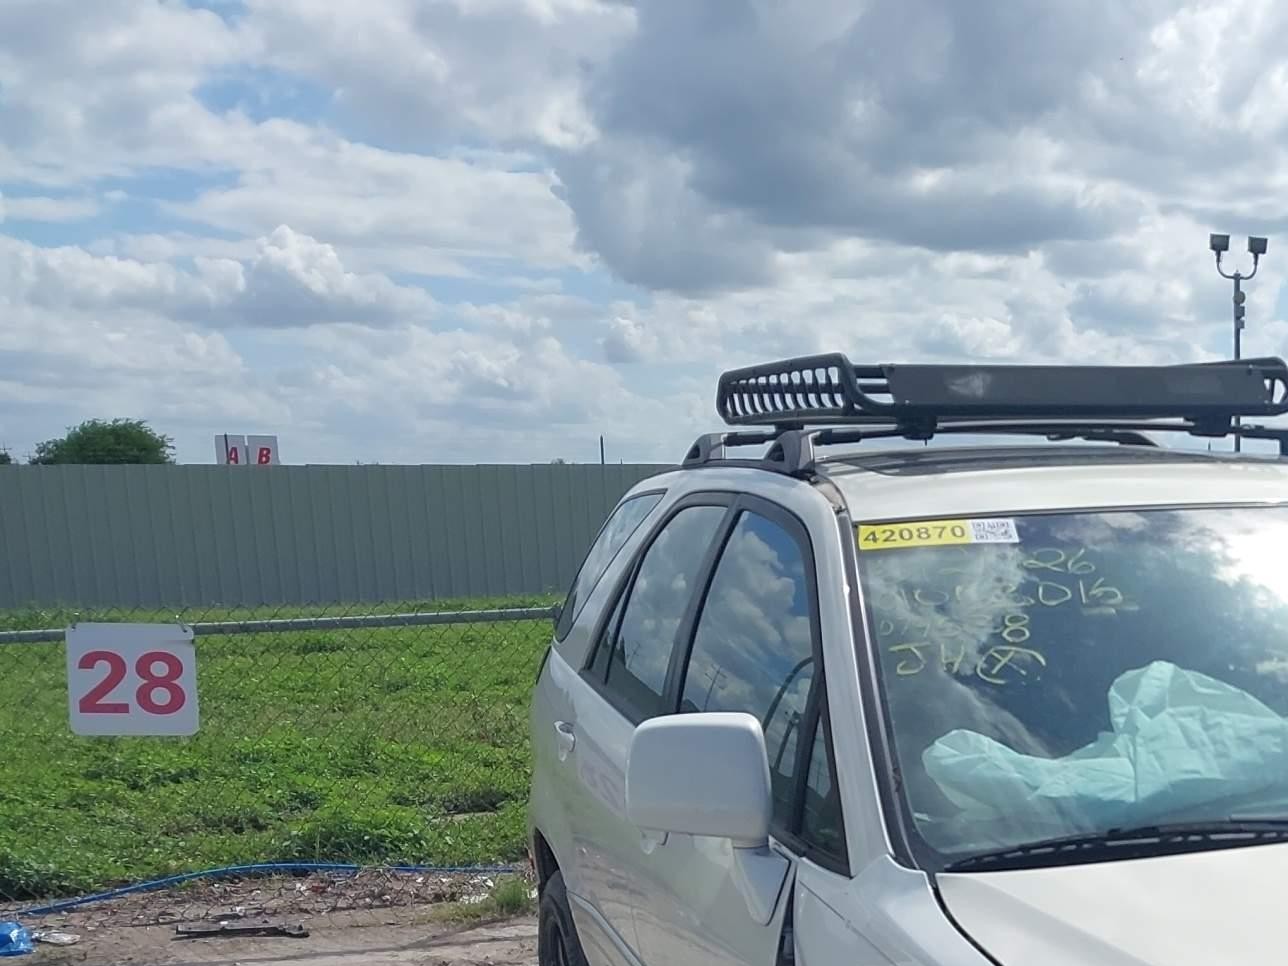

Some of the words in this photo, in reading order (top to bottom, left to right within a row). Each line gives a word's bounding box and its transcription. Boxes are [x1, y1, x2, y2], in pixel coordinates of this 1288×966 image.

[229, 446, 239, 465] A
[258, 447, 272, 465] B
[863, 524, 966, 544] 420870
[78, 650, 187, 716] 28
